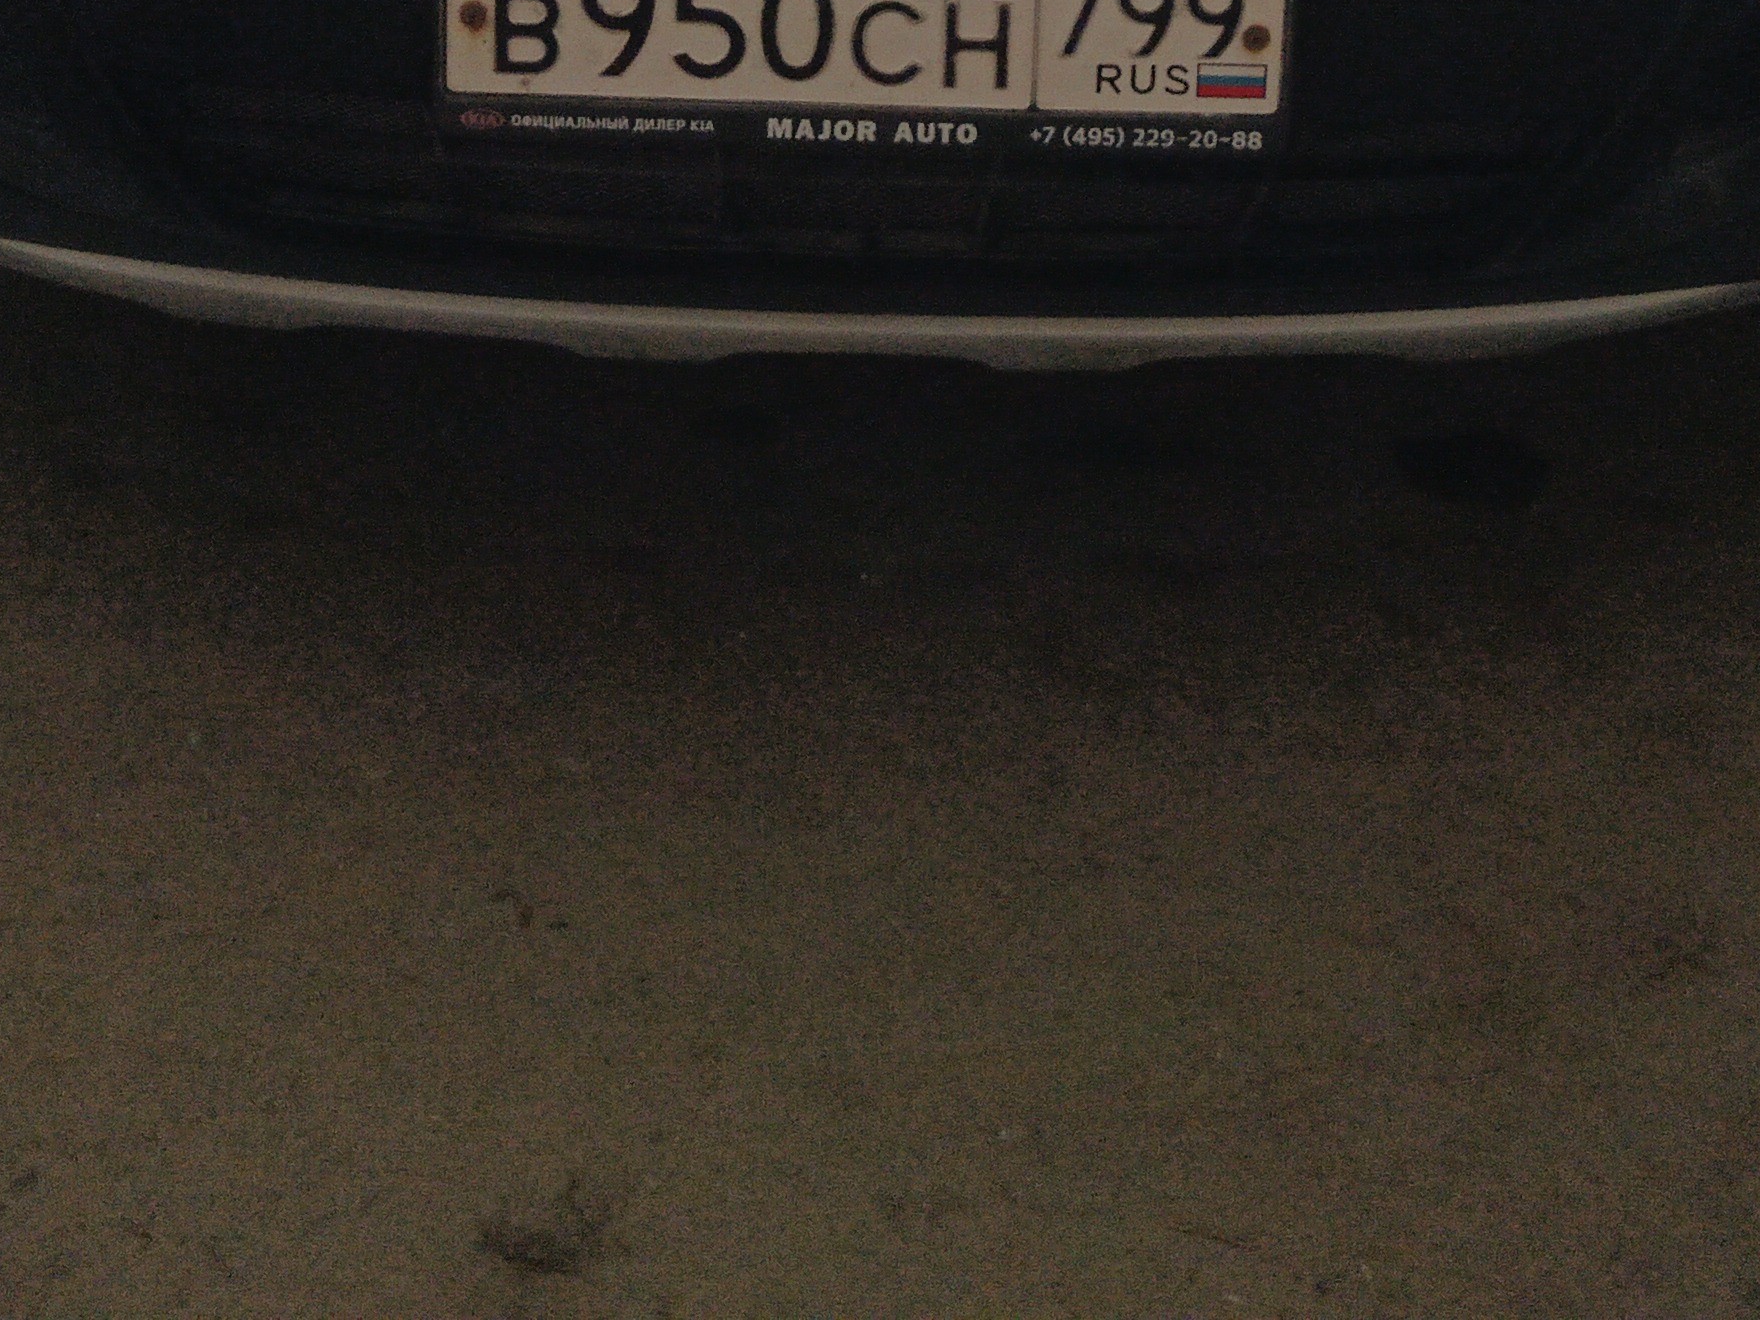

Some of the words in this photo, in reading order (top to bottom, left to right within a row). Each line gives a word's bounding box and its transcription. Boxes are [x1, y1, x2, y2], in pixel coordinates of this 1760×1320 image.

[1094, 62, 1191, 97] RUS
[510, 112, 630, 132] ОФИЦИАЛЬНЫЙ
[632, 116, 687, 134] ДИЛЕР
[689, 118, 715, 133] KIA
[766, 116, 878, 143] MAJOR
[893, 120, 979, 146] AUTO
[1028, 126, 1056, 145] +7
[1062, 125, 1126, 149] (495)
[1132, 127, 1263, 152] 229-20-88
